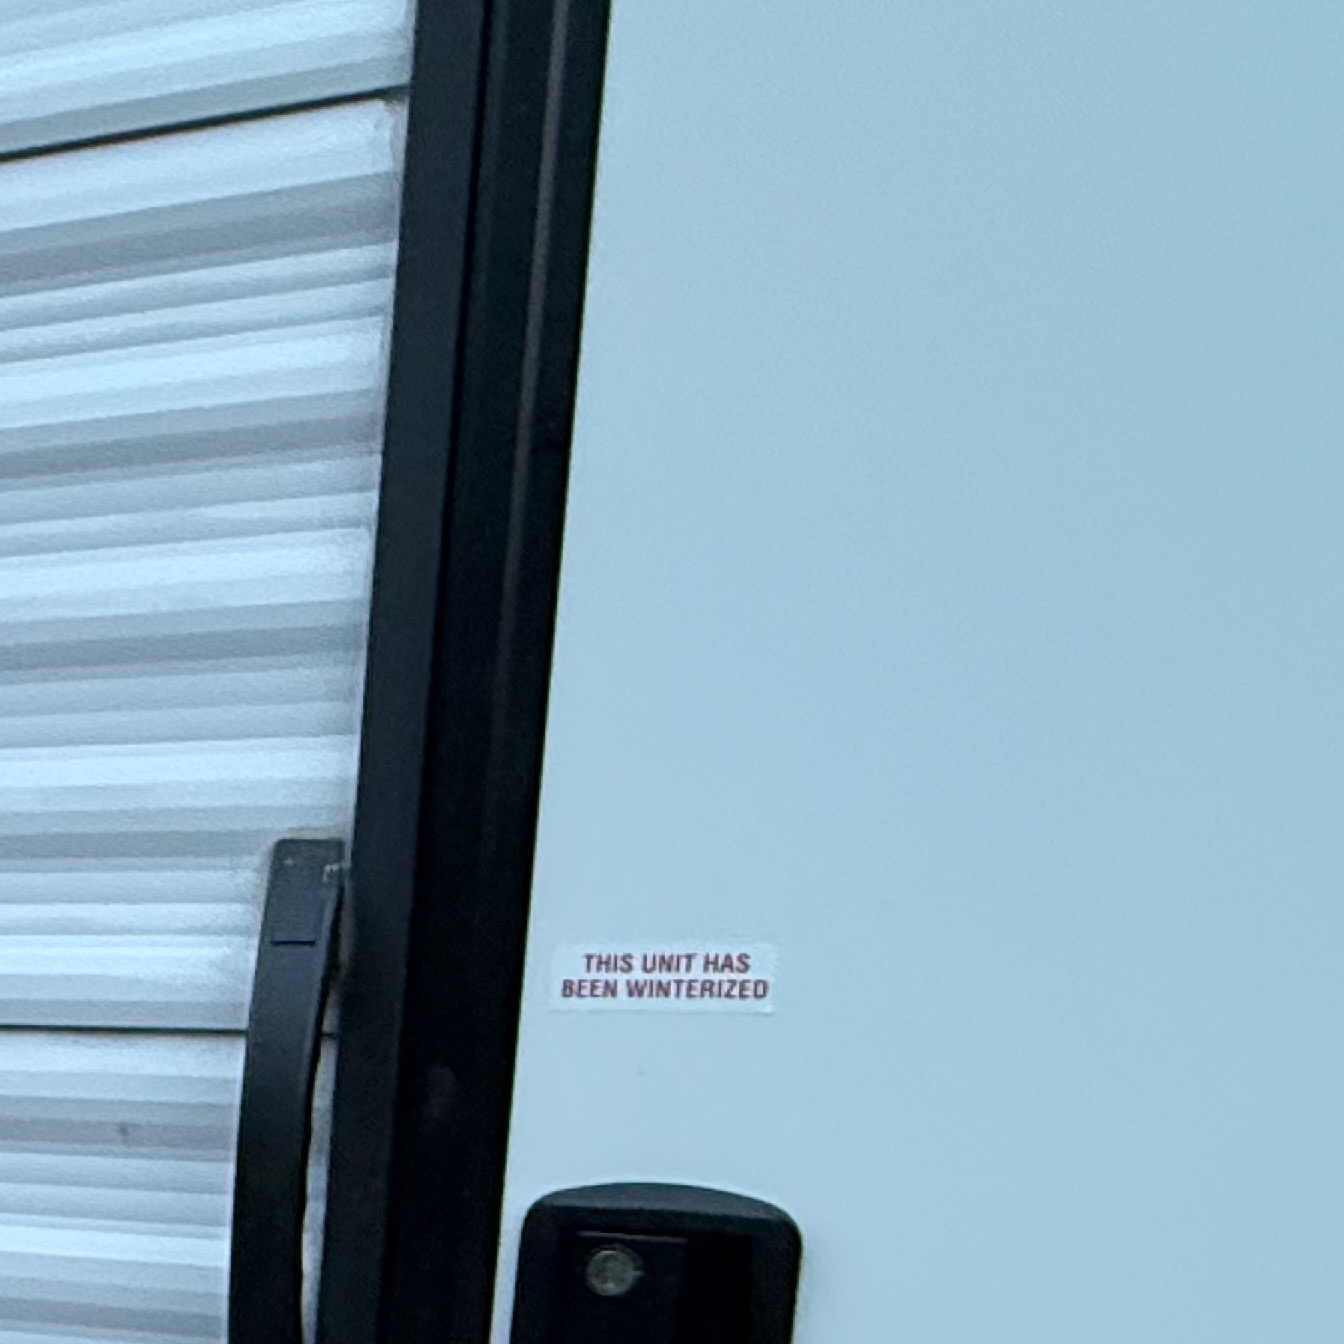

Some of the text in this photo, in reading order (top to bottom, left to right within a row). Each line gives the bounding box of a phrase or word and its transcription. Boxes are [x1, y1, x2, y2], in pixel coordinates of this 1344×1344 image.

[584, 952, 752, 974] THIS UNIT HAS
[561, 978, 770, 999] BEEN WINTERIZED
